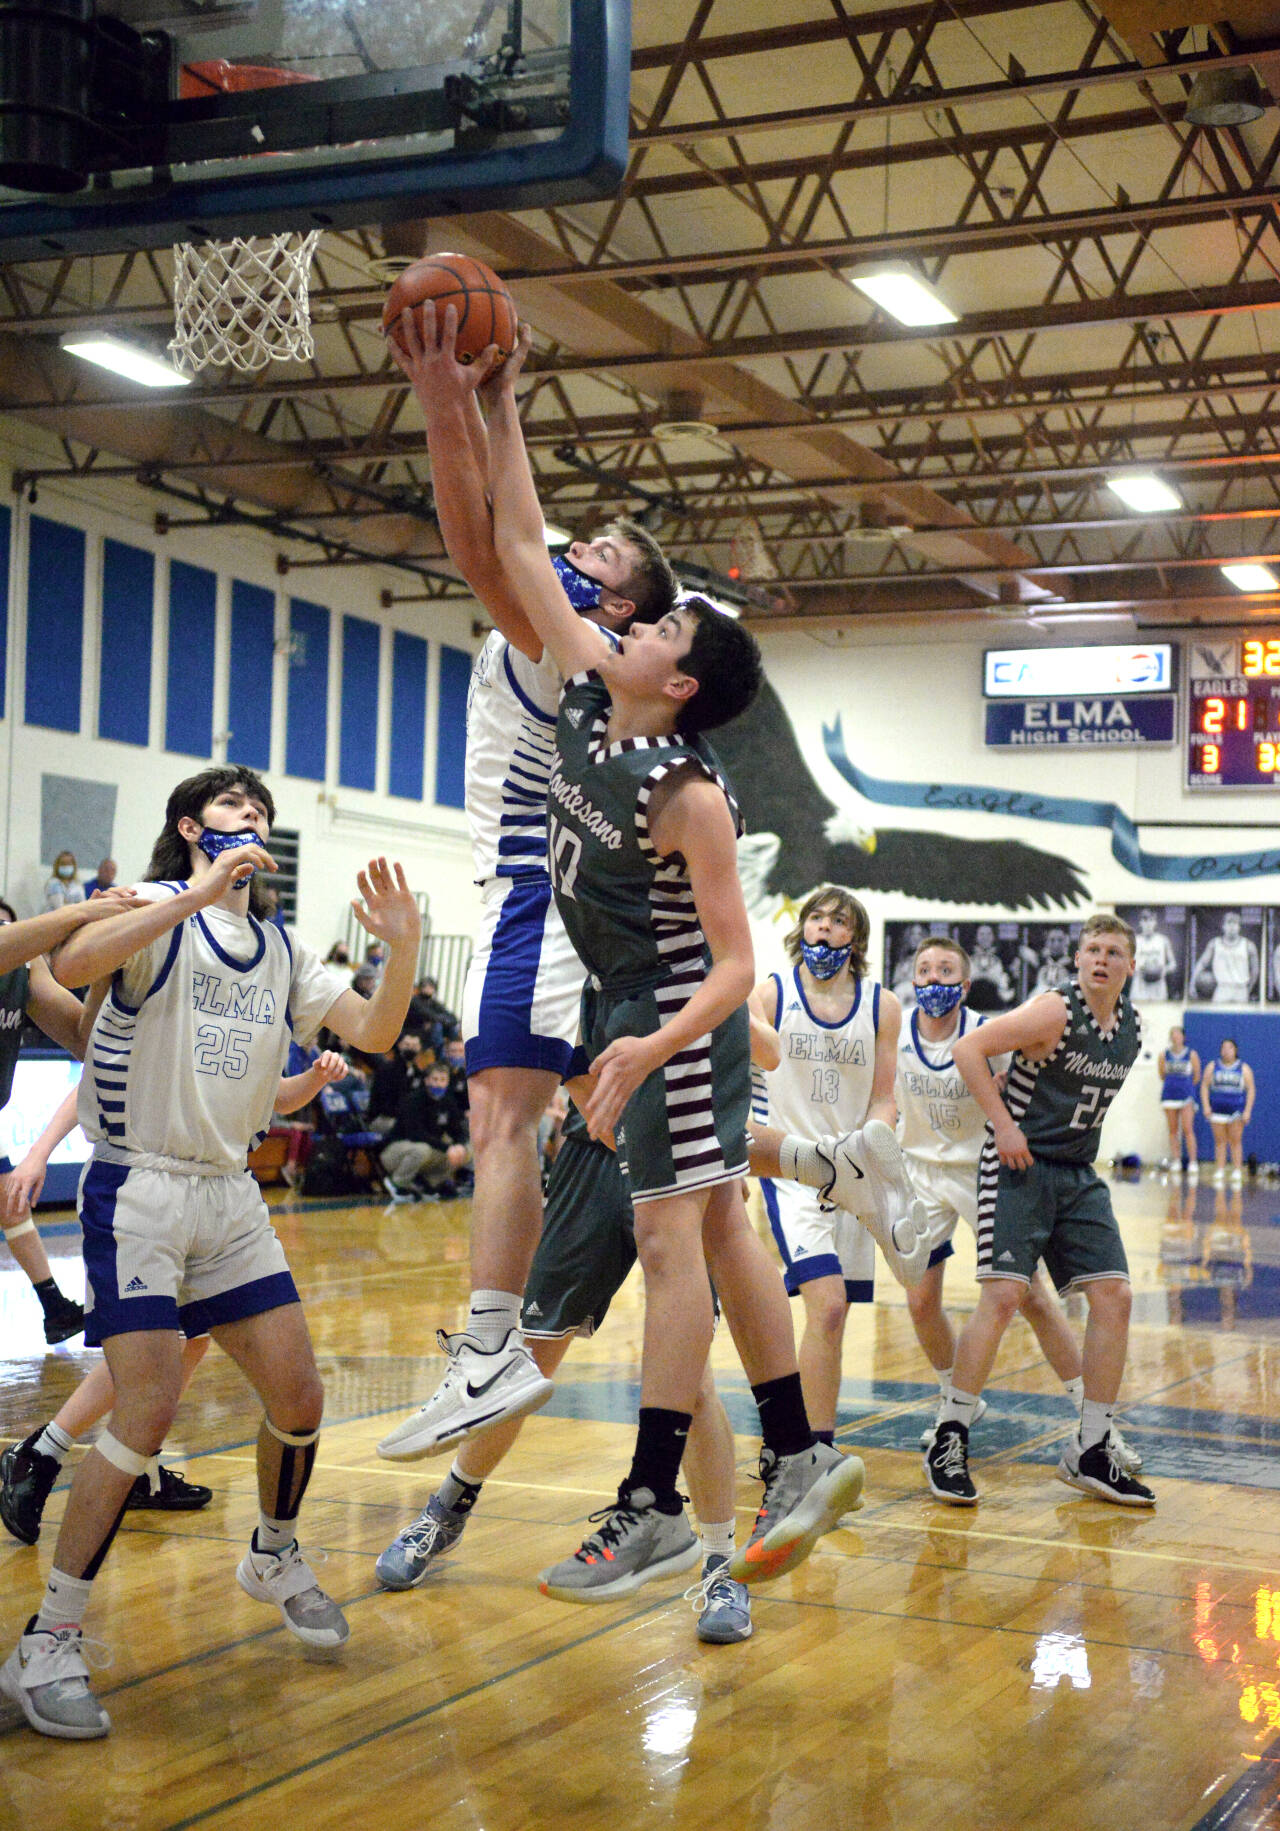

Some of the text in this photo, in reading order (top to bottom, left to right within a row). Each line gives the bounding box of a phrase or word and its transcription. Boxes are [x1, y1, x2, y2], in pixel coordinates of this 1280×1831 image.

[1193, 680, 1248, 696] EAGLES
[1024, 700, 1132, 728] ELMA
[1203, 698, 1247, 733] 21
[1011, 727, 1146, 744] HIGH SCHOOL
[1202, 744, 1220, 773] 3
[924, 784, 1064, 817] Eagle
[1188, 853, 1280, 880] Pri
[194, 1024, 252, 1080] 25
[789, 1033, 867, 1066] ELMA
[811, 1068, 840, 1105] 13
[928, 1103, 961, 1131] 15
